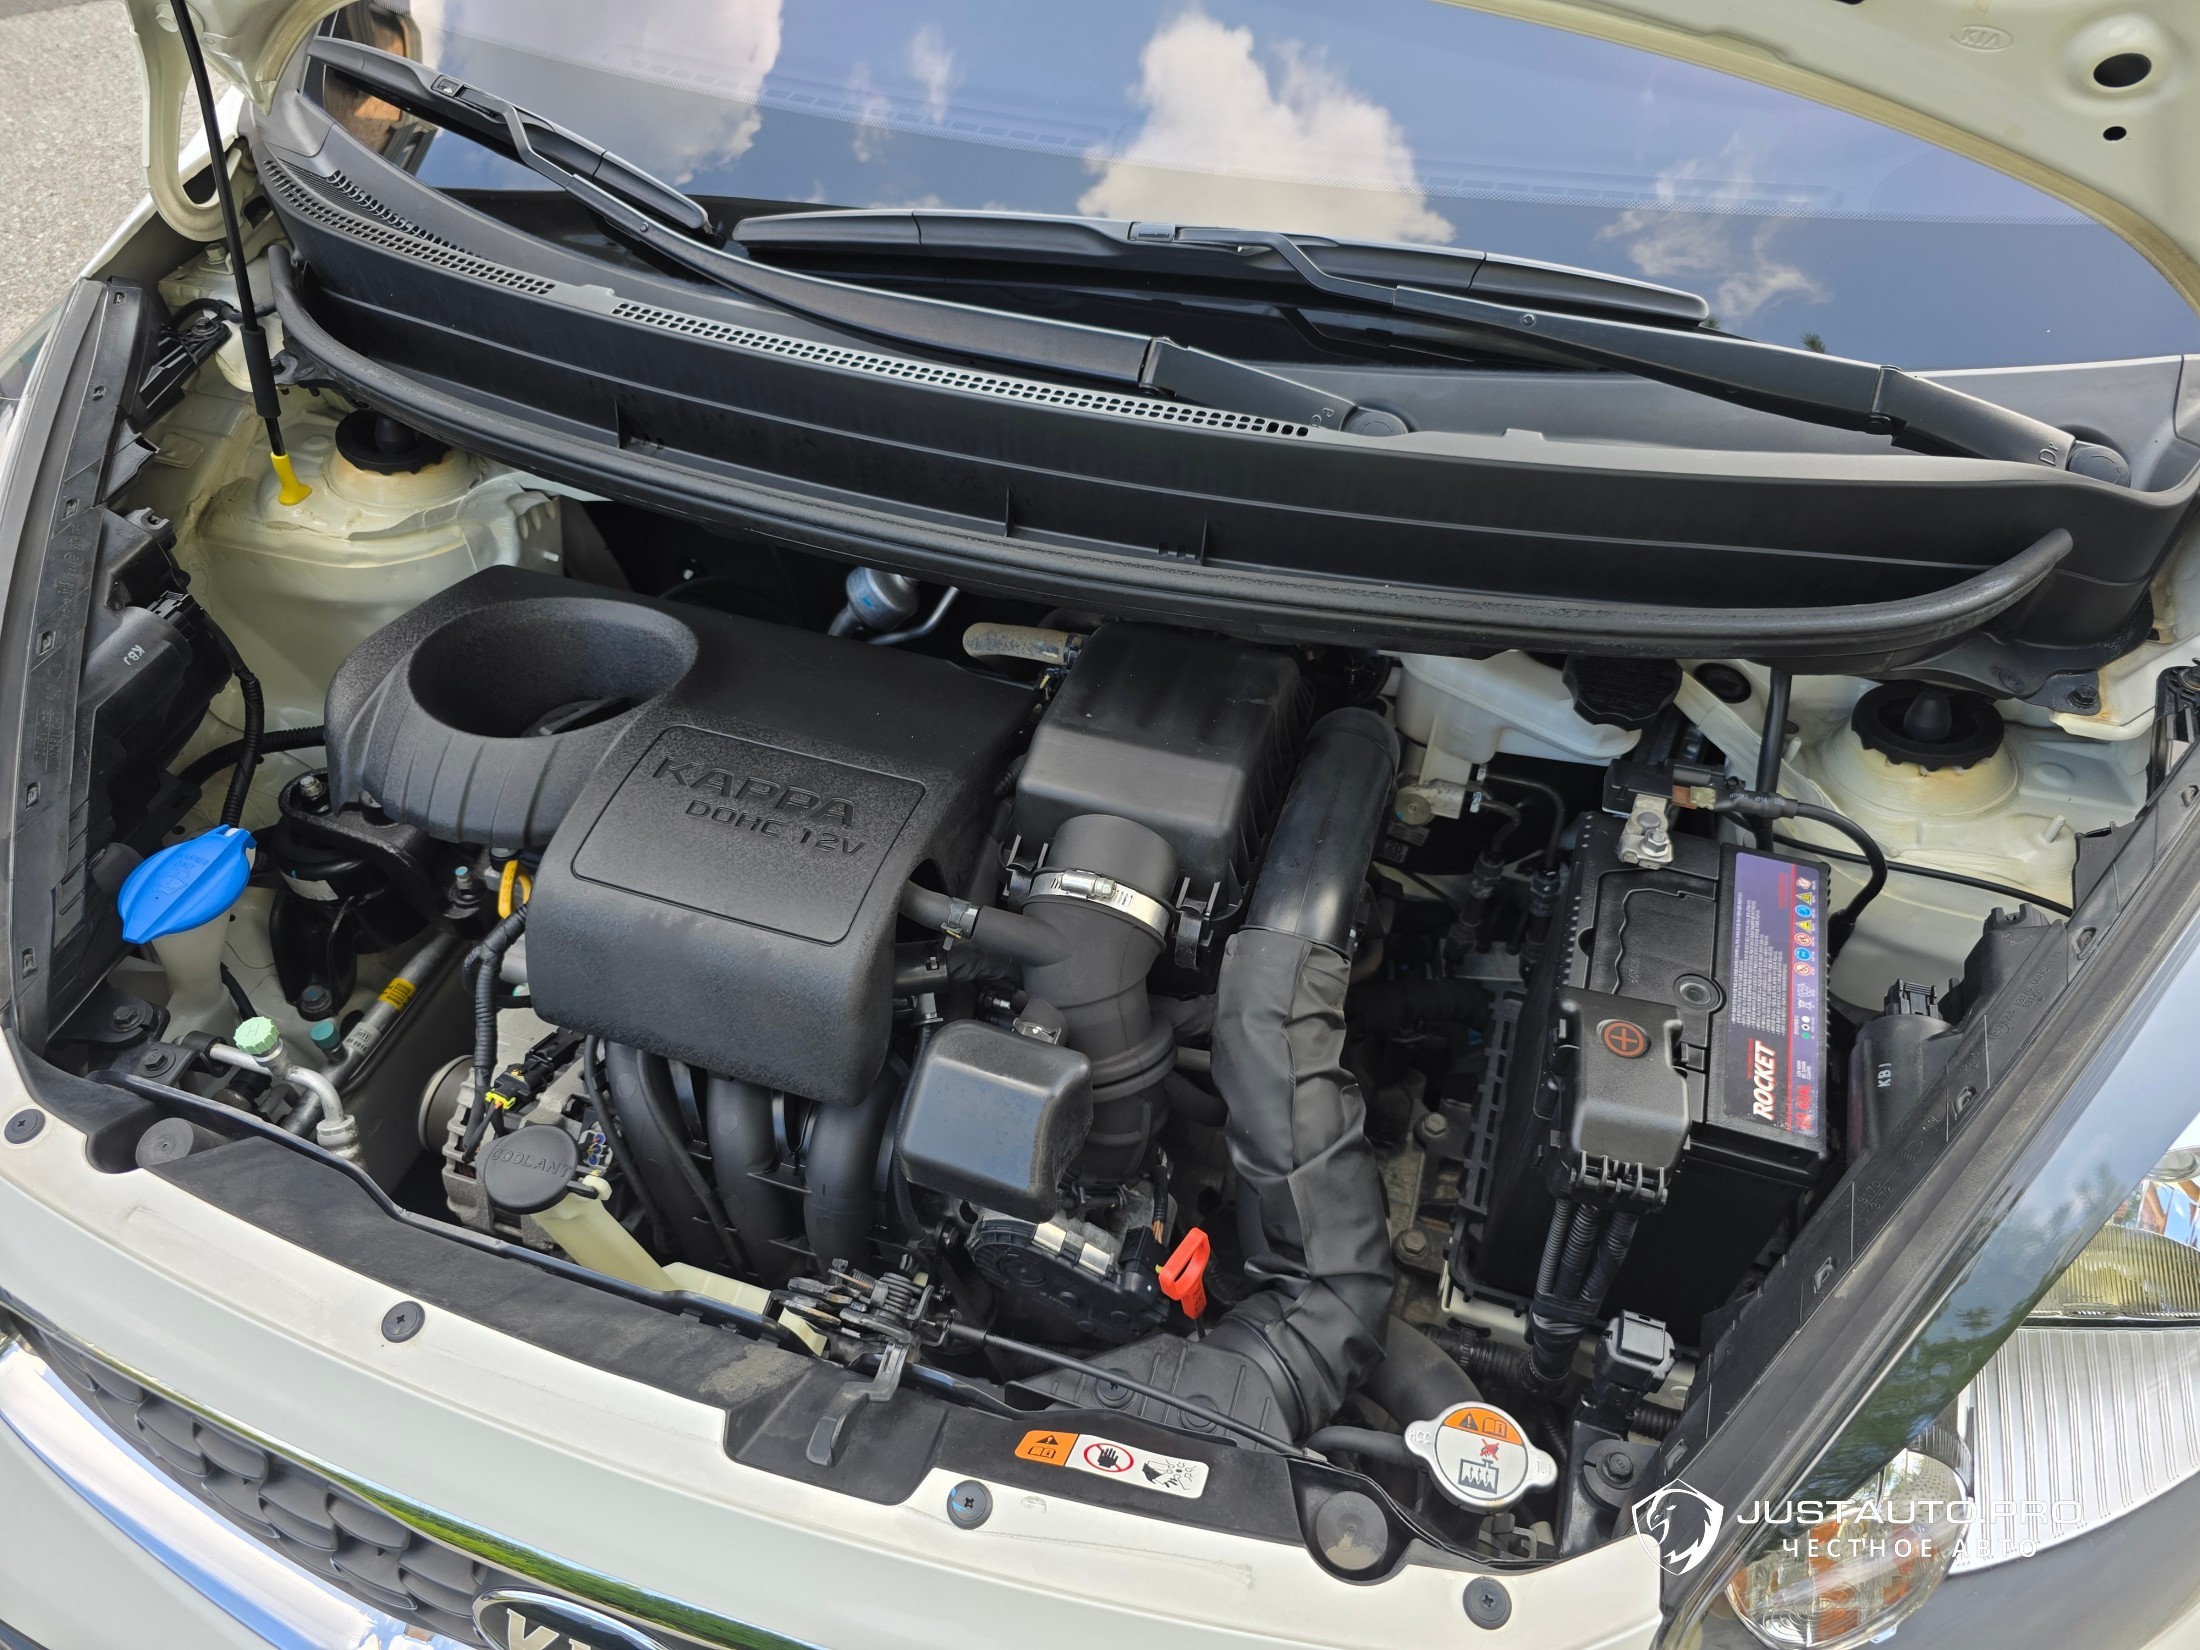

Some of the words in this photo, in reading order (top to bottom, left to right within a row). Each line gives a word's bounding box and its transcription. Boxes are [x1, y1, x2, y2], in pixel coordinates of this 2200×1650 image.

[2039, 441, 2058, 467] Dr
[652, 756, 855, 828] KAPPA
[685, 800, 787, 838] DOHC
[800, 828, 868, 855] 12V
[246, 1023, 261, 1037] H
[1752, 1040, 1776, 1121] ROCKET
[491, 1148, 573, 1178] COOLANT
[1408, 1429, 1432, 1446] HCC
